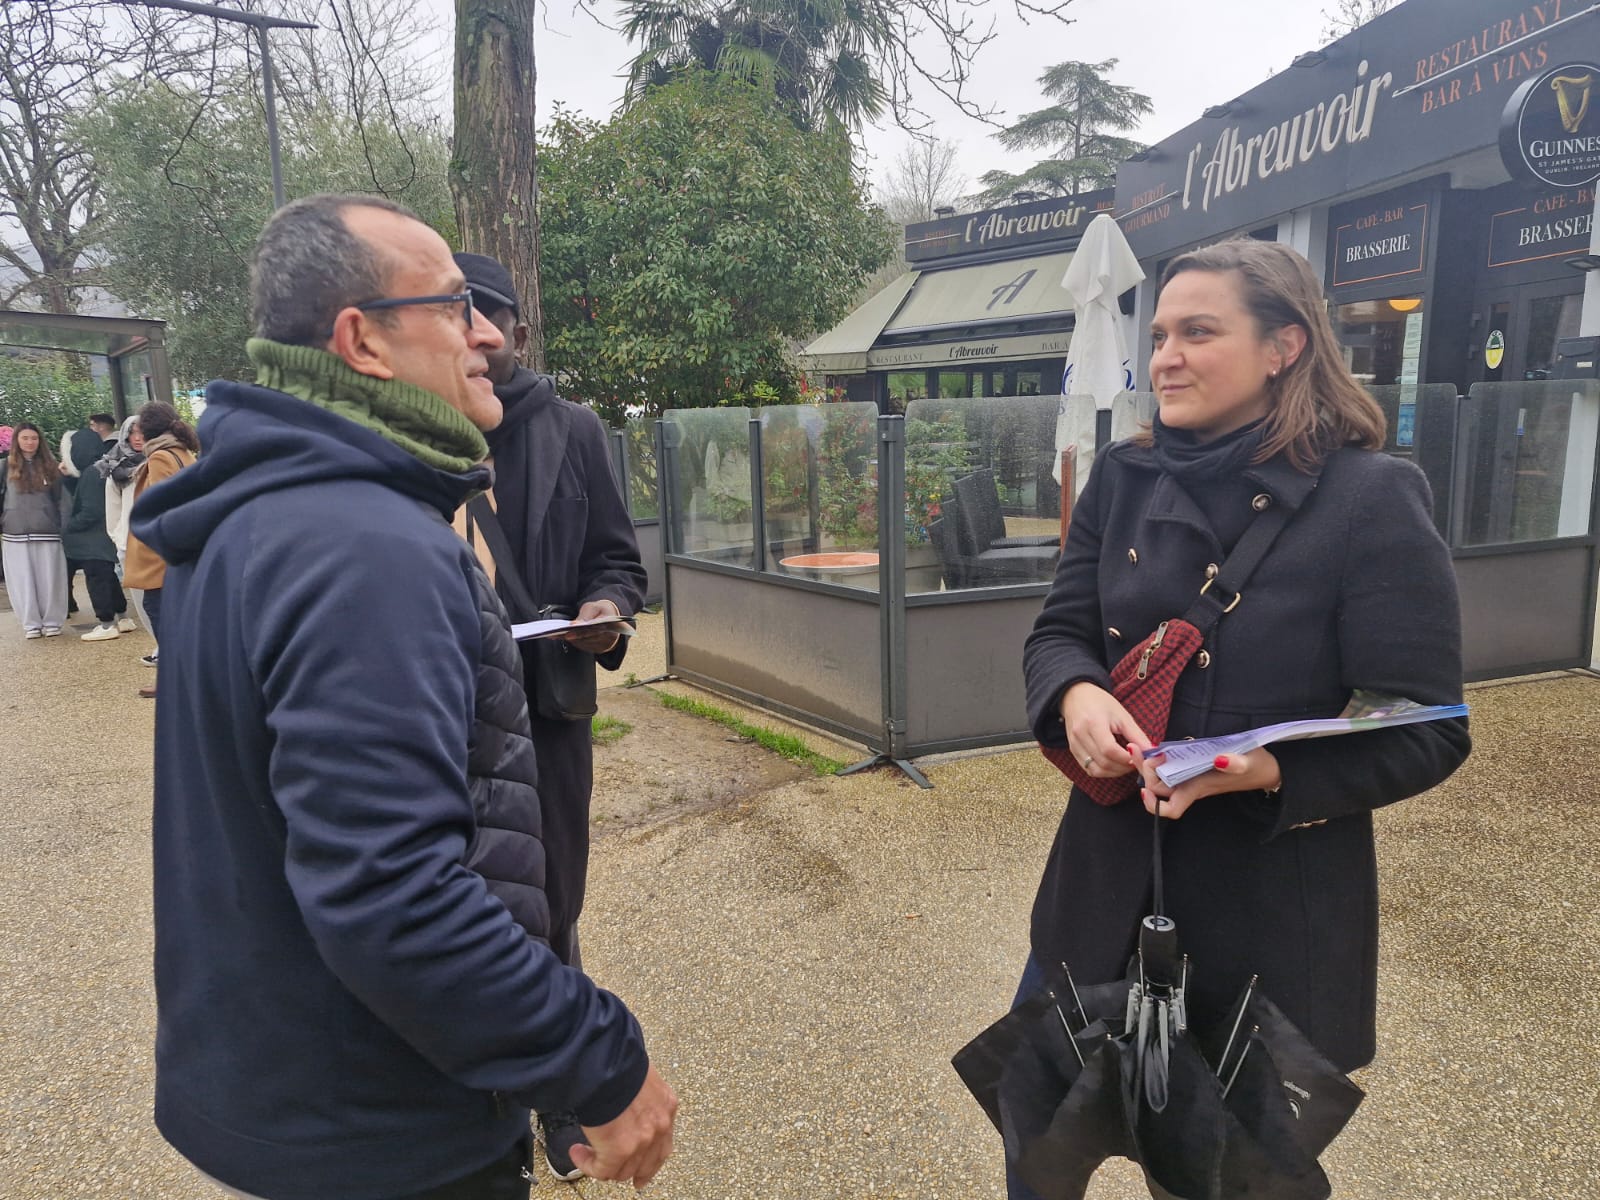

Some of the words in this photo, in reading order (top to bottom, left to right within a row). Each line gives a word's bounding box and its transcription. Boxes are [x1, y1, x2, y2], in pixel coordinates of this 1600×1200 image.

[1421, 79, 1462, 113] BAR
[1491, 41, 1549, 84] VINS
[1182, 60, 1392, 213] l'Abreuvoir
[965, 201, 1086, 245] l'Abreuvoir
[1384, 207, 1404, 223] BAR
[1346, 234, 1411, 263] BRASSERIE
[876, 352, 924, 364] RESTAURANT
[949, 343, 998, 358] l'Abreuvoir
